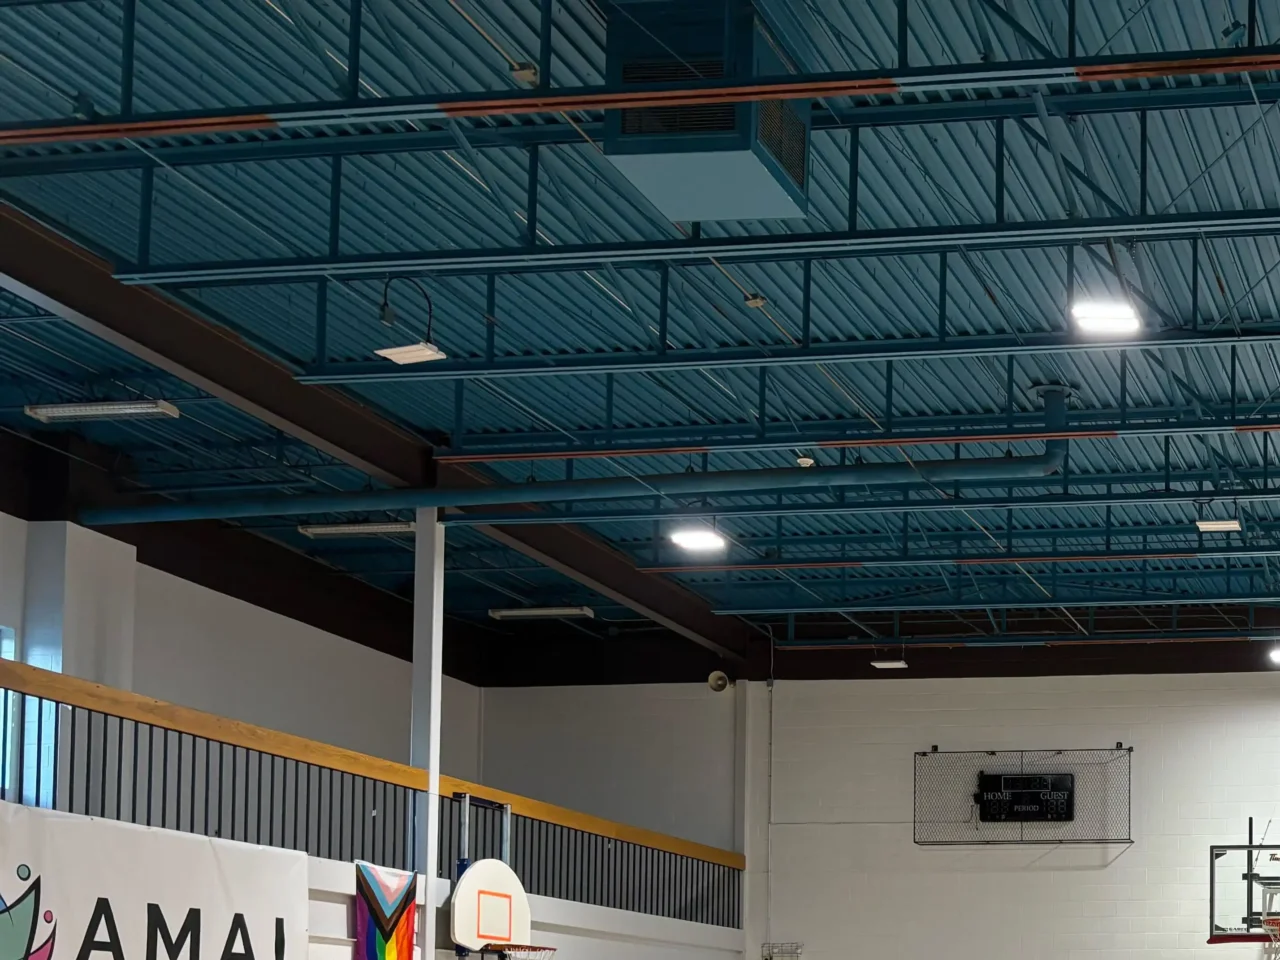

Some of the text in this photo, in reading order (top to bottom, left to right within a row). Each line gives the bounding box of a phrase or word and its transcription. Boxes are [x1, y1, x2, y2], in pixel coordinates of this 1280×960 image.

[983, 791, 1069, 800] HOME GUEST
[1014, 804, 1039, 812] PERIOD
[1269, 853, 1280, 862] Tim
